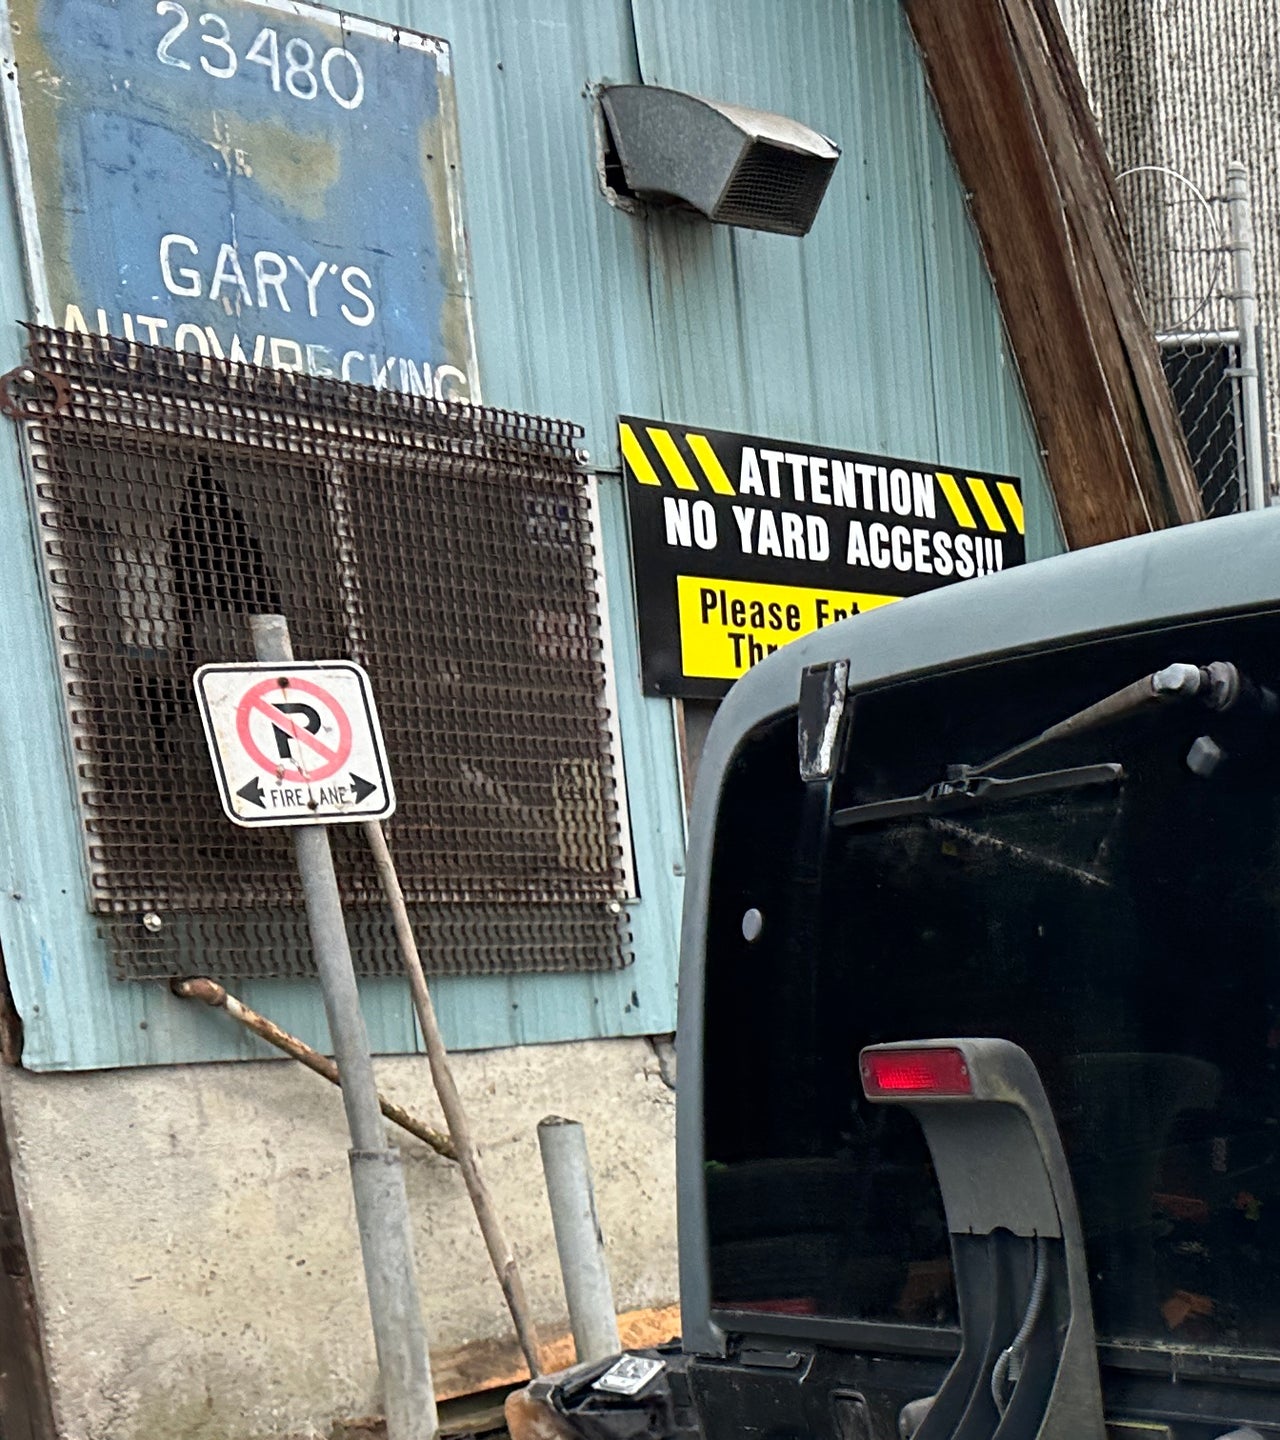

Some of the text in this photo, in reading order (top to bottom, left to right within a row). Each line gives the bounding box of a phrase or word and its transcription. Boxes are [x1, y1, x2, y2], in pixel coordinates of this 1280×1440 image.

[156, 0, 365, 109] 23480
[159, 233, 376, 327] GARY'S
[740, 447, 936, 519] ATTENTION
[663, 496, 1004, 578] NO YARD ACCESS!!!
[700, 588, 801, 631] Please
[270, 787, 306, 808] FIRE
